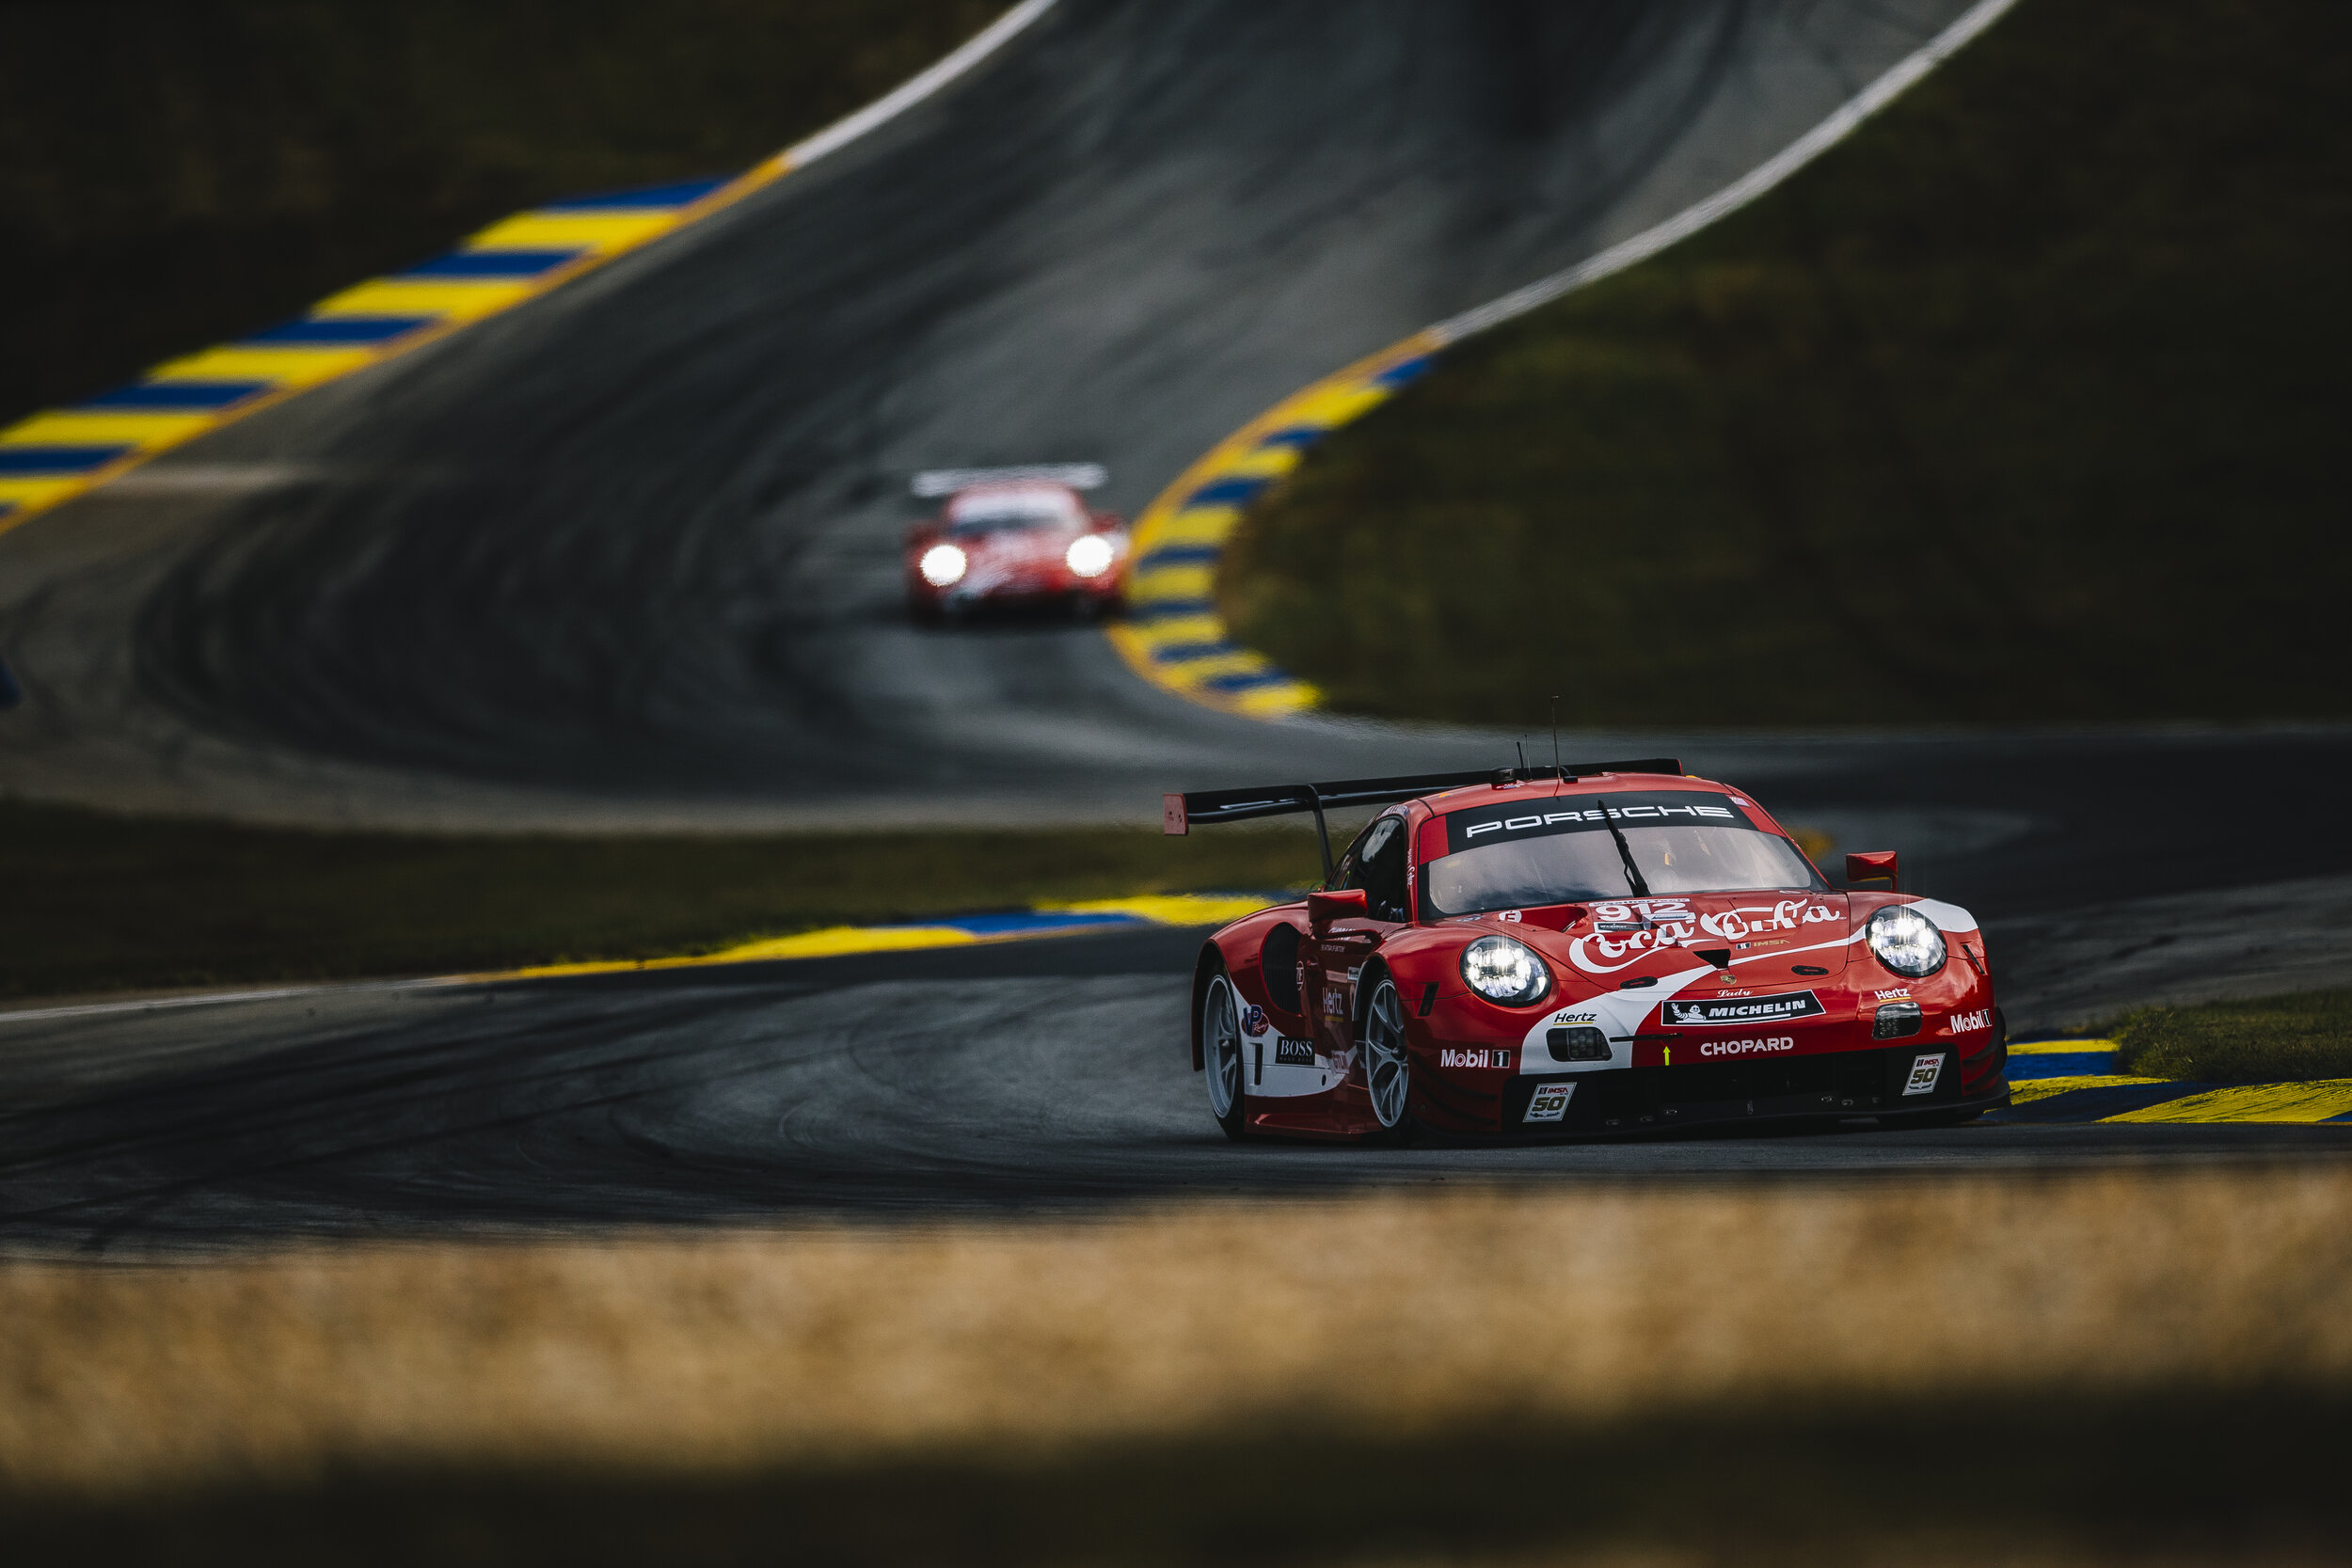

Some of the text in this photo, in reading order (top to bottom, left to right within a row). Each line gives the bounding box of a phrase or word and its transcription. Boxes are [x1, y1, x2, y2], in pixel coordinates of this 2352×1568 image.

[1466, 805, 1735, 838] PORSCHE
[1595, 902, 1689, 921] 912
[1753, 939, 1791, 947] IMSA
[1322, 987, 1343, 1015] Hertz
[1716, 989, 1754, 998] Lady
[1874, 988, 1911, 1000] Hertz
[1553, 1012, 1597, 1023] Hertz
[1708, 1000, 1806, 1018] MICHELIN
[1243, 1004, 1263, 1037] VP
[1950, 1009, 1985, 1034] Mobil
[1279, 1039, 1313, 1057] BOSS
[1700, 1037, 1794, 1056] CHOPARD
[1440, 1049, 1489, 1069] Mobil
[1910, 1068, 1938, 1085] 50
[1547, 1086, 1568, 1095] IMSA
[1531, 1096, 1566, 1112] 50
